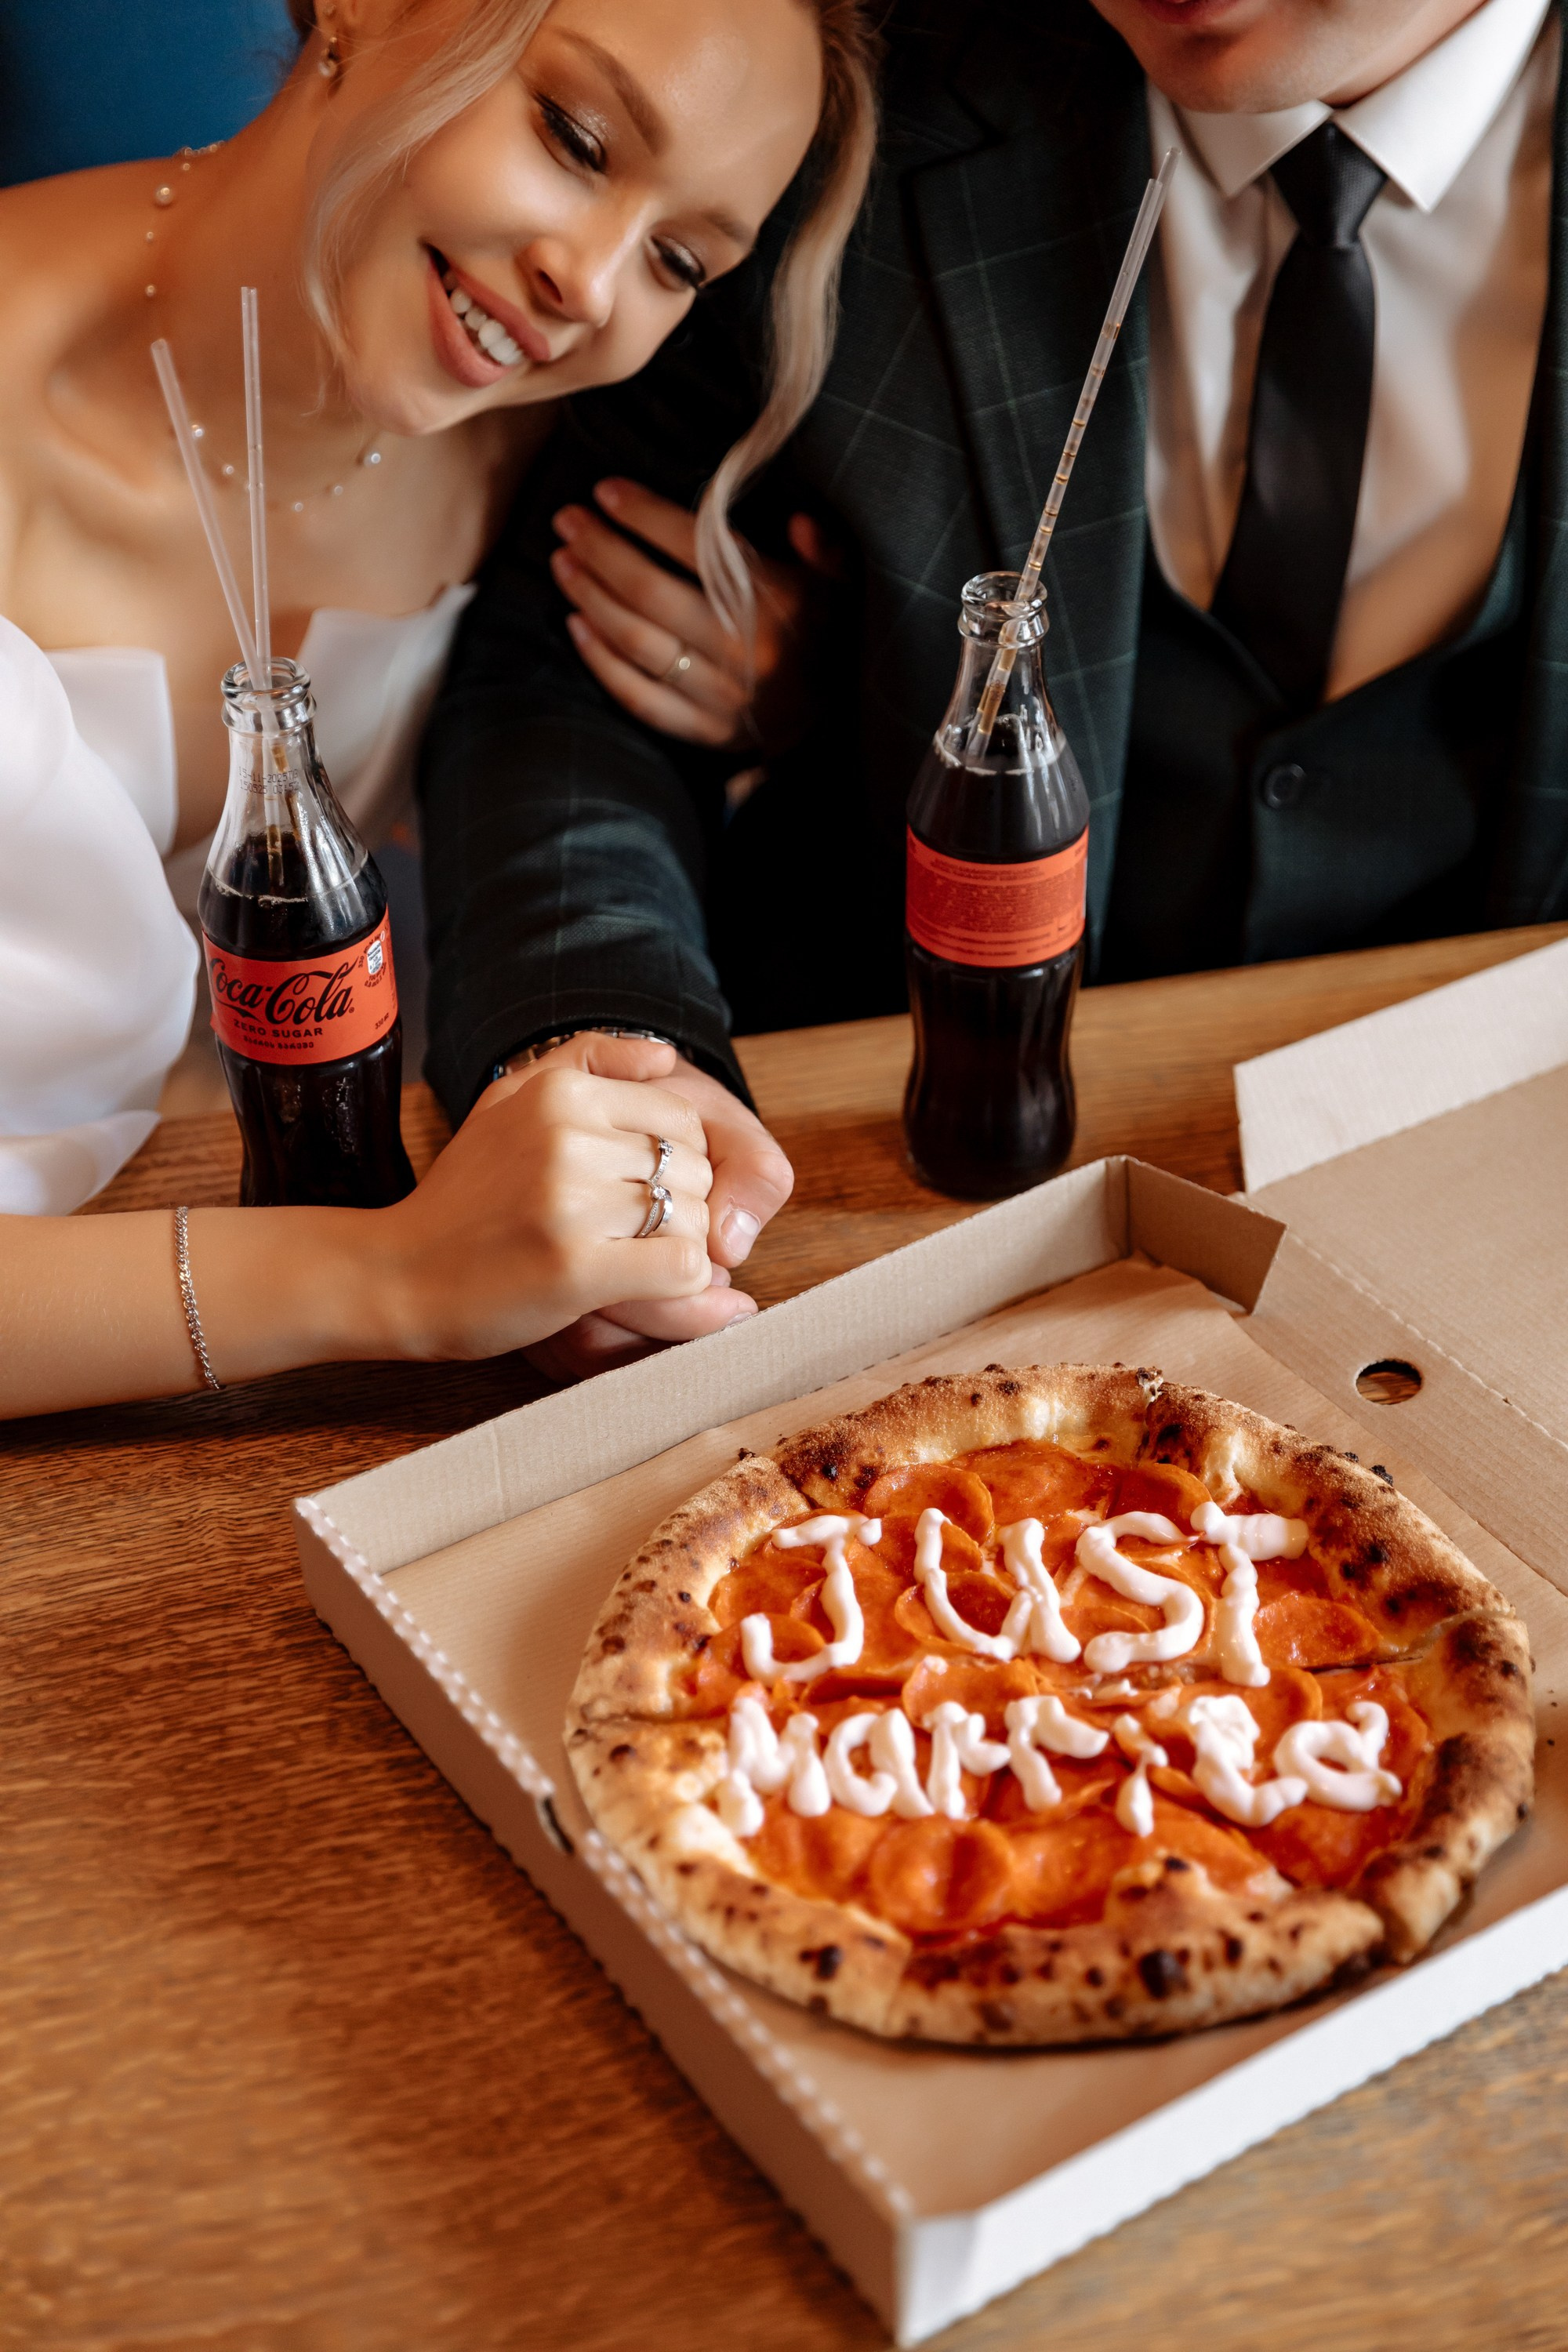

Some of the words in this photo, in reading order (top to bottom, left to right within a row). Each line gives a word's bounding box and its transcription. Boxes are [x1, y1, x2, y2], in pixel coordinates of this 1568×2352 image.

[210, 956, 358, 1025] Coca-Cola
[234, 1019, 267, 1036] ZERO
[272, 1027, 323, 1038] SUGAR
[739, 1501, 1309, 1687] JUST
